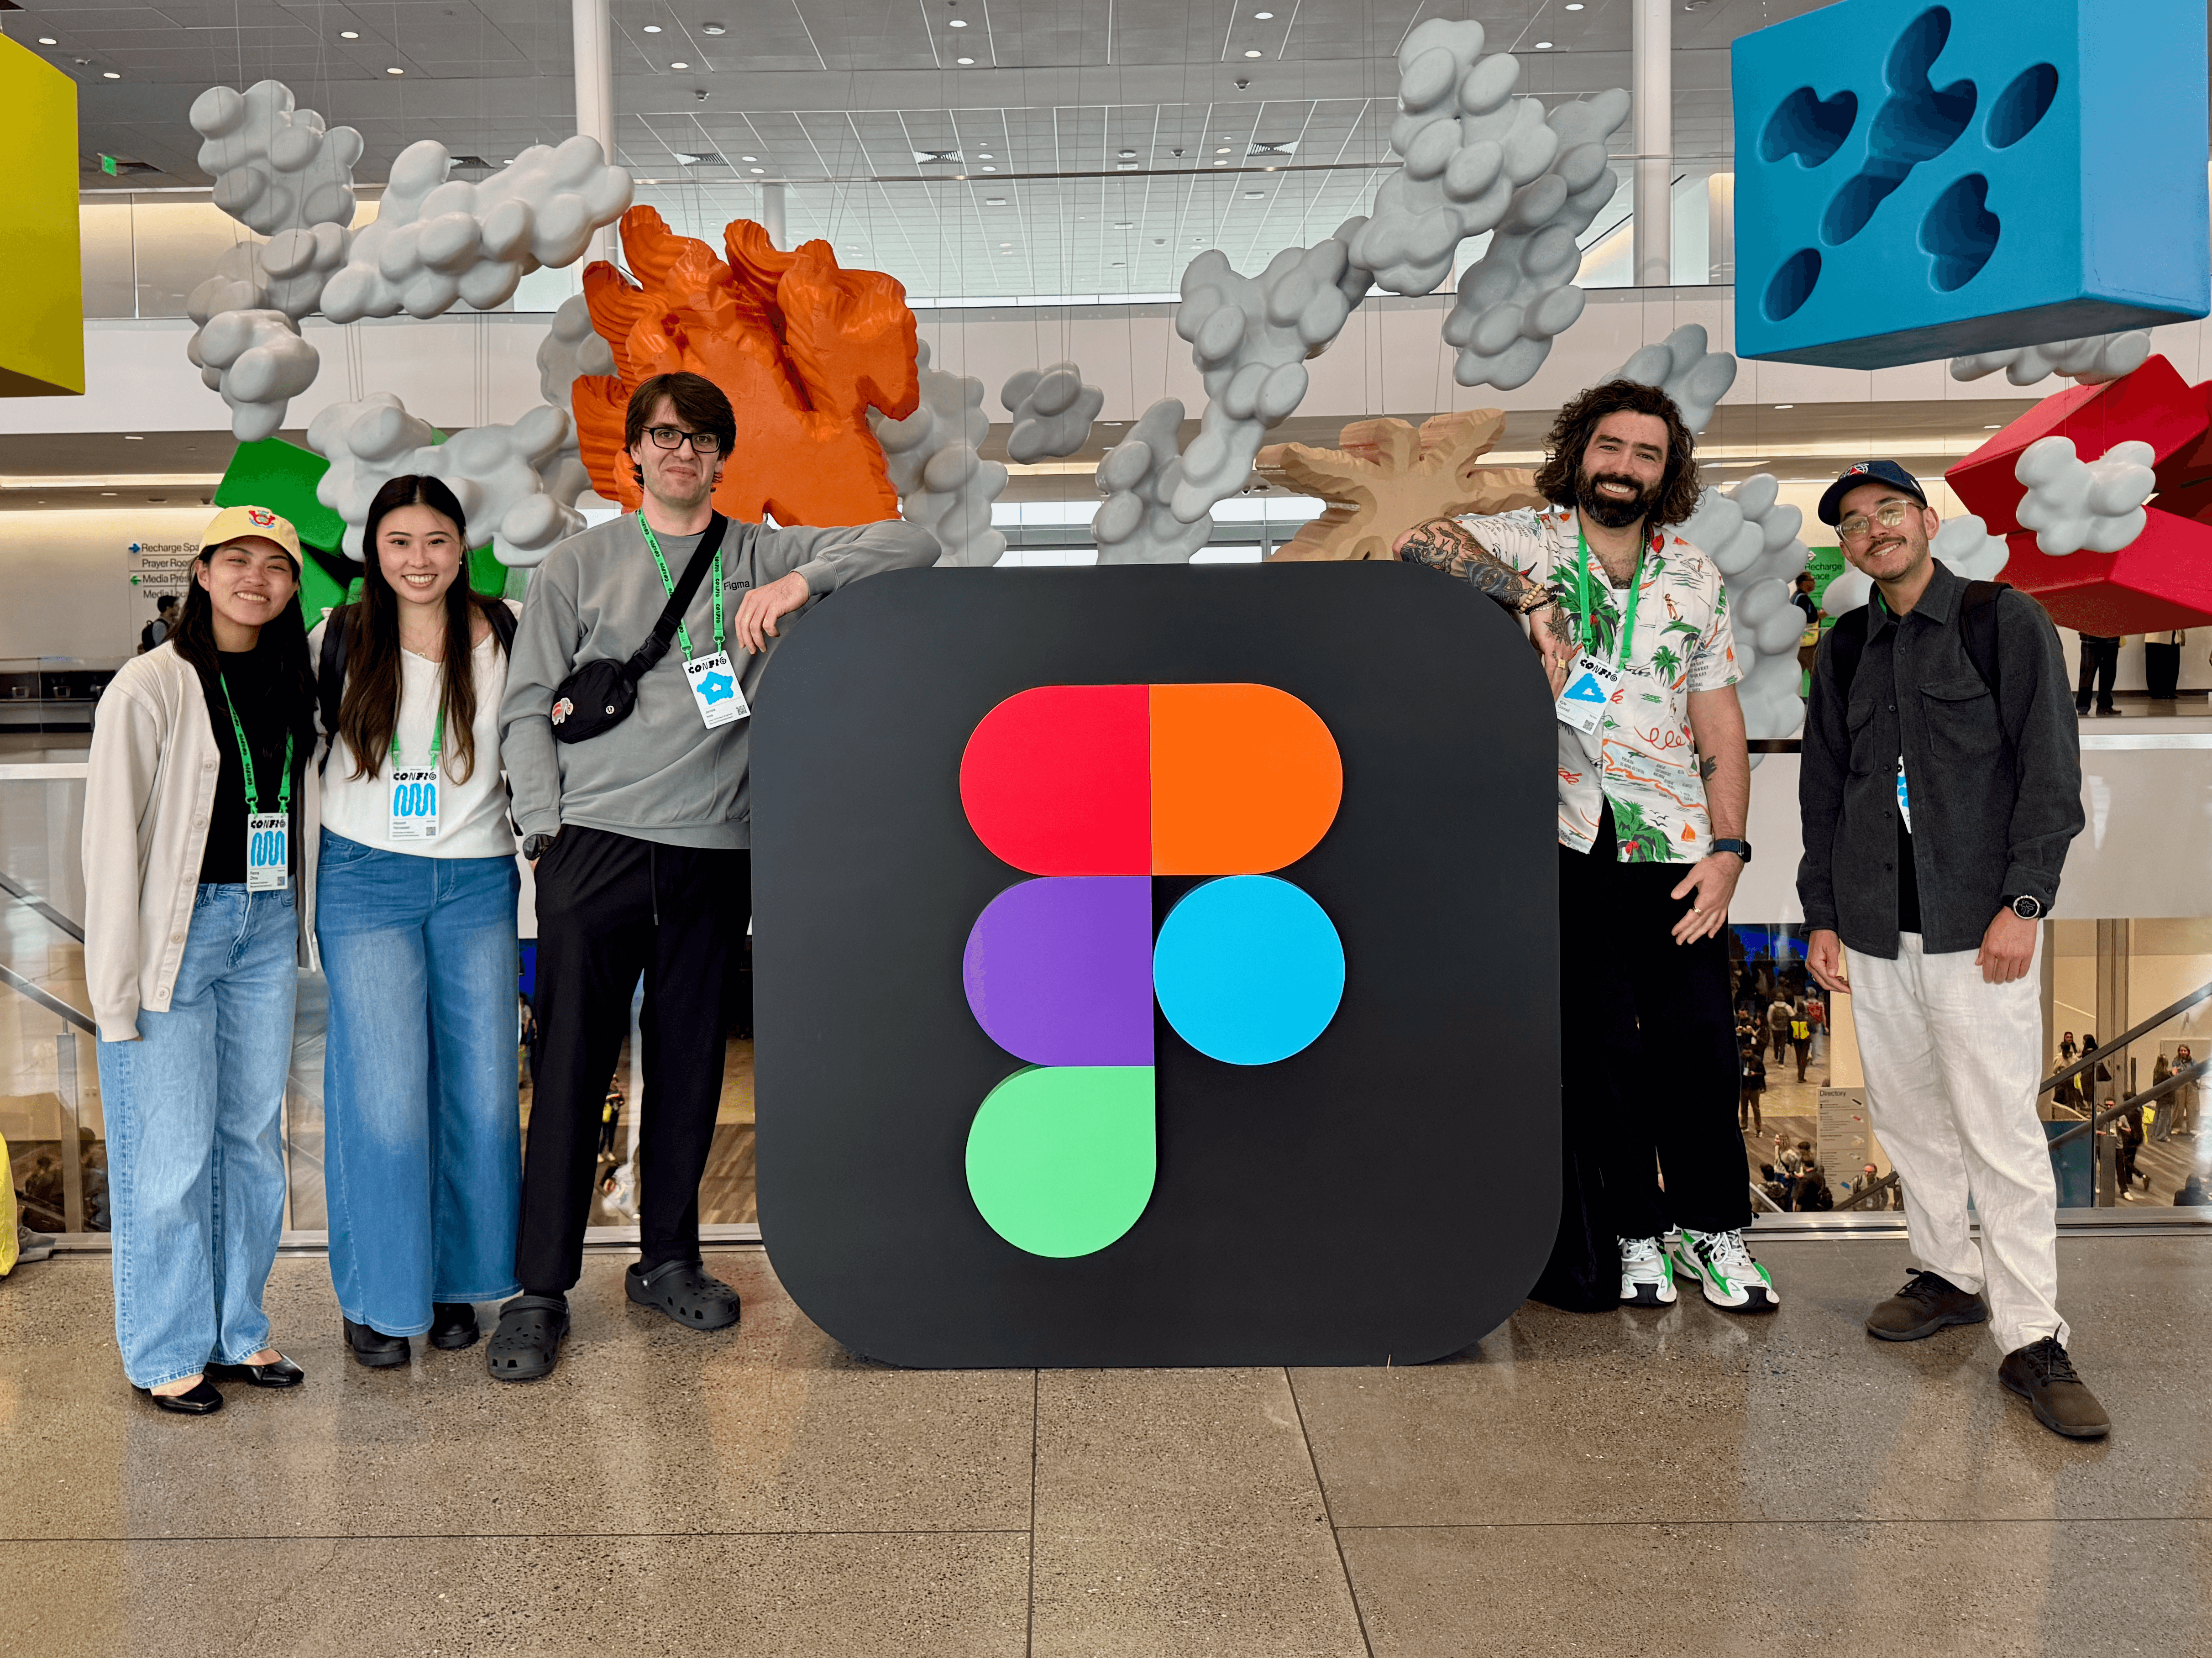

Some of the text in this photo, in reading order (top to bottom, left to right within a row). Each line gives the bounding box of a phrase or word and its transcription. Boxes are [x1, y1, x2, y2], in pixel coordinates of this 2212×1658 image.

[142, 542, 199, 553] Recharge Spa
[142, 558, 188, 569] Prayer Roo
[1805, 562, 1842, 572] Recharge
[143, 574, 189, 583] Media Pres
[723, 581, 750, 591] Figma
[688, 657, 727, 674] CONFIG
[1580, 659, 1618, 682] CONFIG
[393, 771, 436, 781] CONFIG
[251, 819, 286, 829] CONFIG
